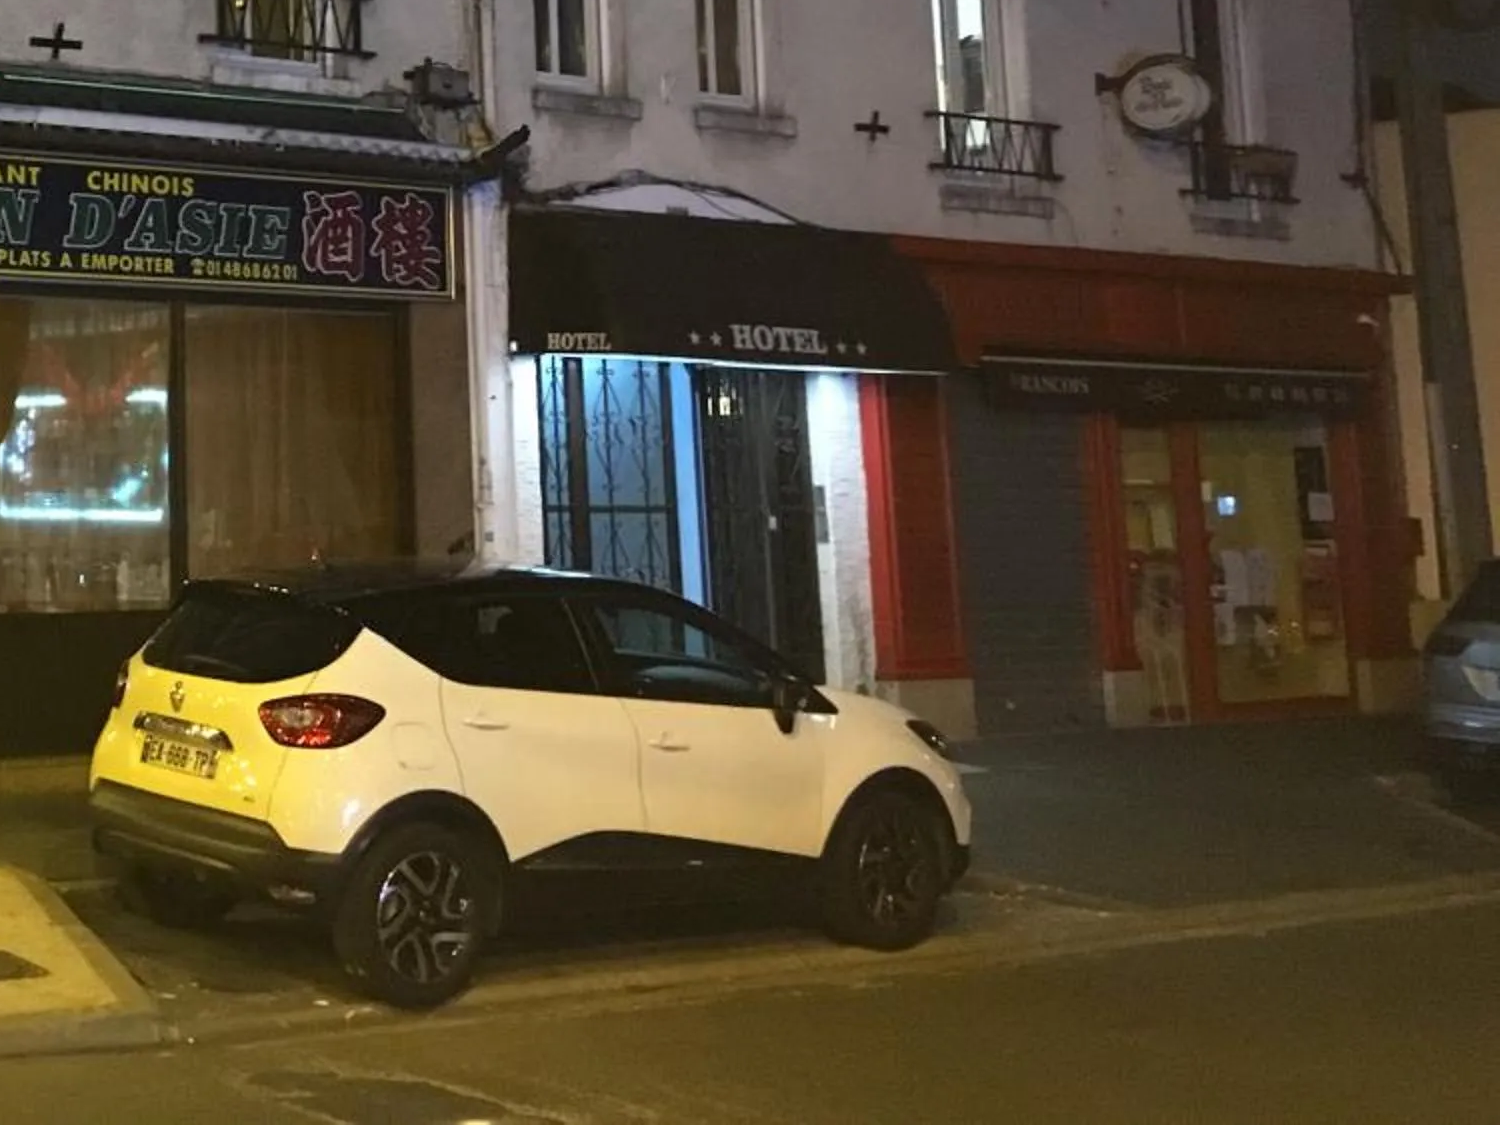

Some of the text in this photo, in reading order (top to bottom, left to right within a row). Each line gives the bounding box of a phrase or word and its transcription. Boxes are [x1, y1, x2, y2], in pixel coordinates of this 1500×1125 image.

[86, 169, 196, 198] CHINOIS
[63, 192, 291, 259] D'ASIE
[59, 251, 73, 269] A
[80, 252, 175, 275] EMPORTER
[546, 331, 612, 351] HOTEL
[728, 324, 828, 355] HOTEL
